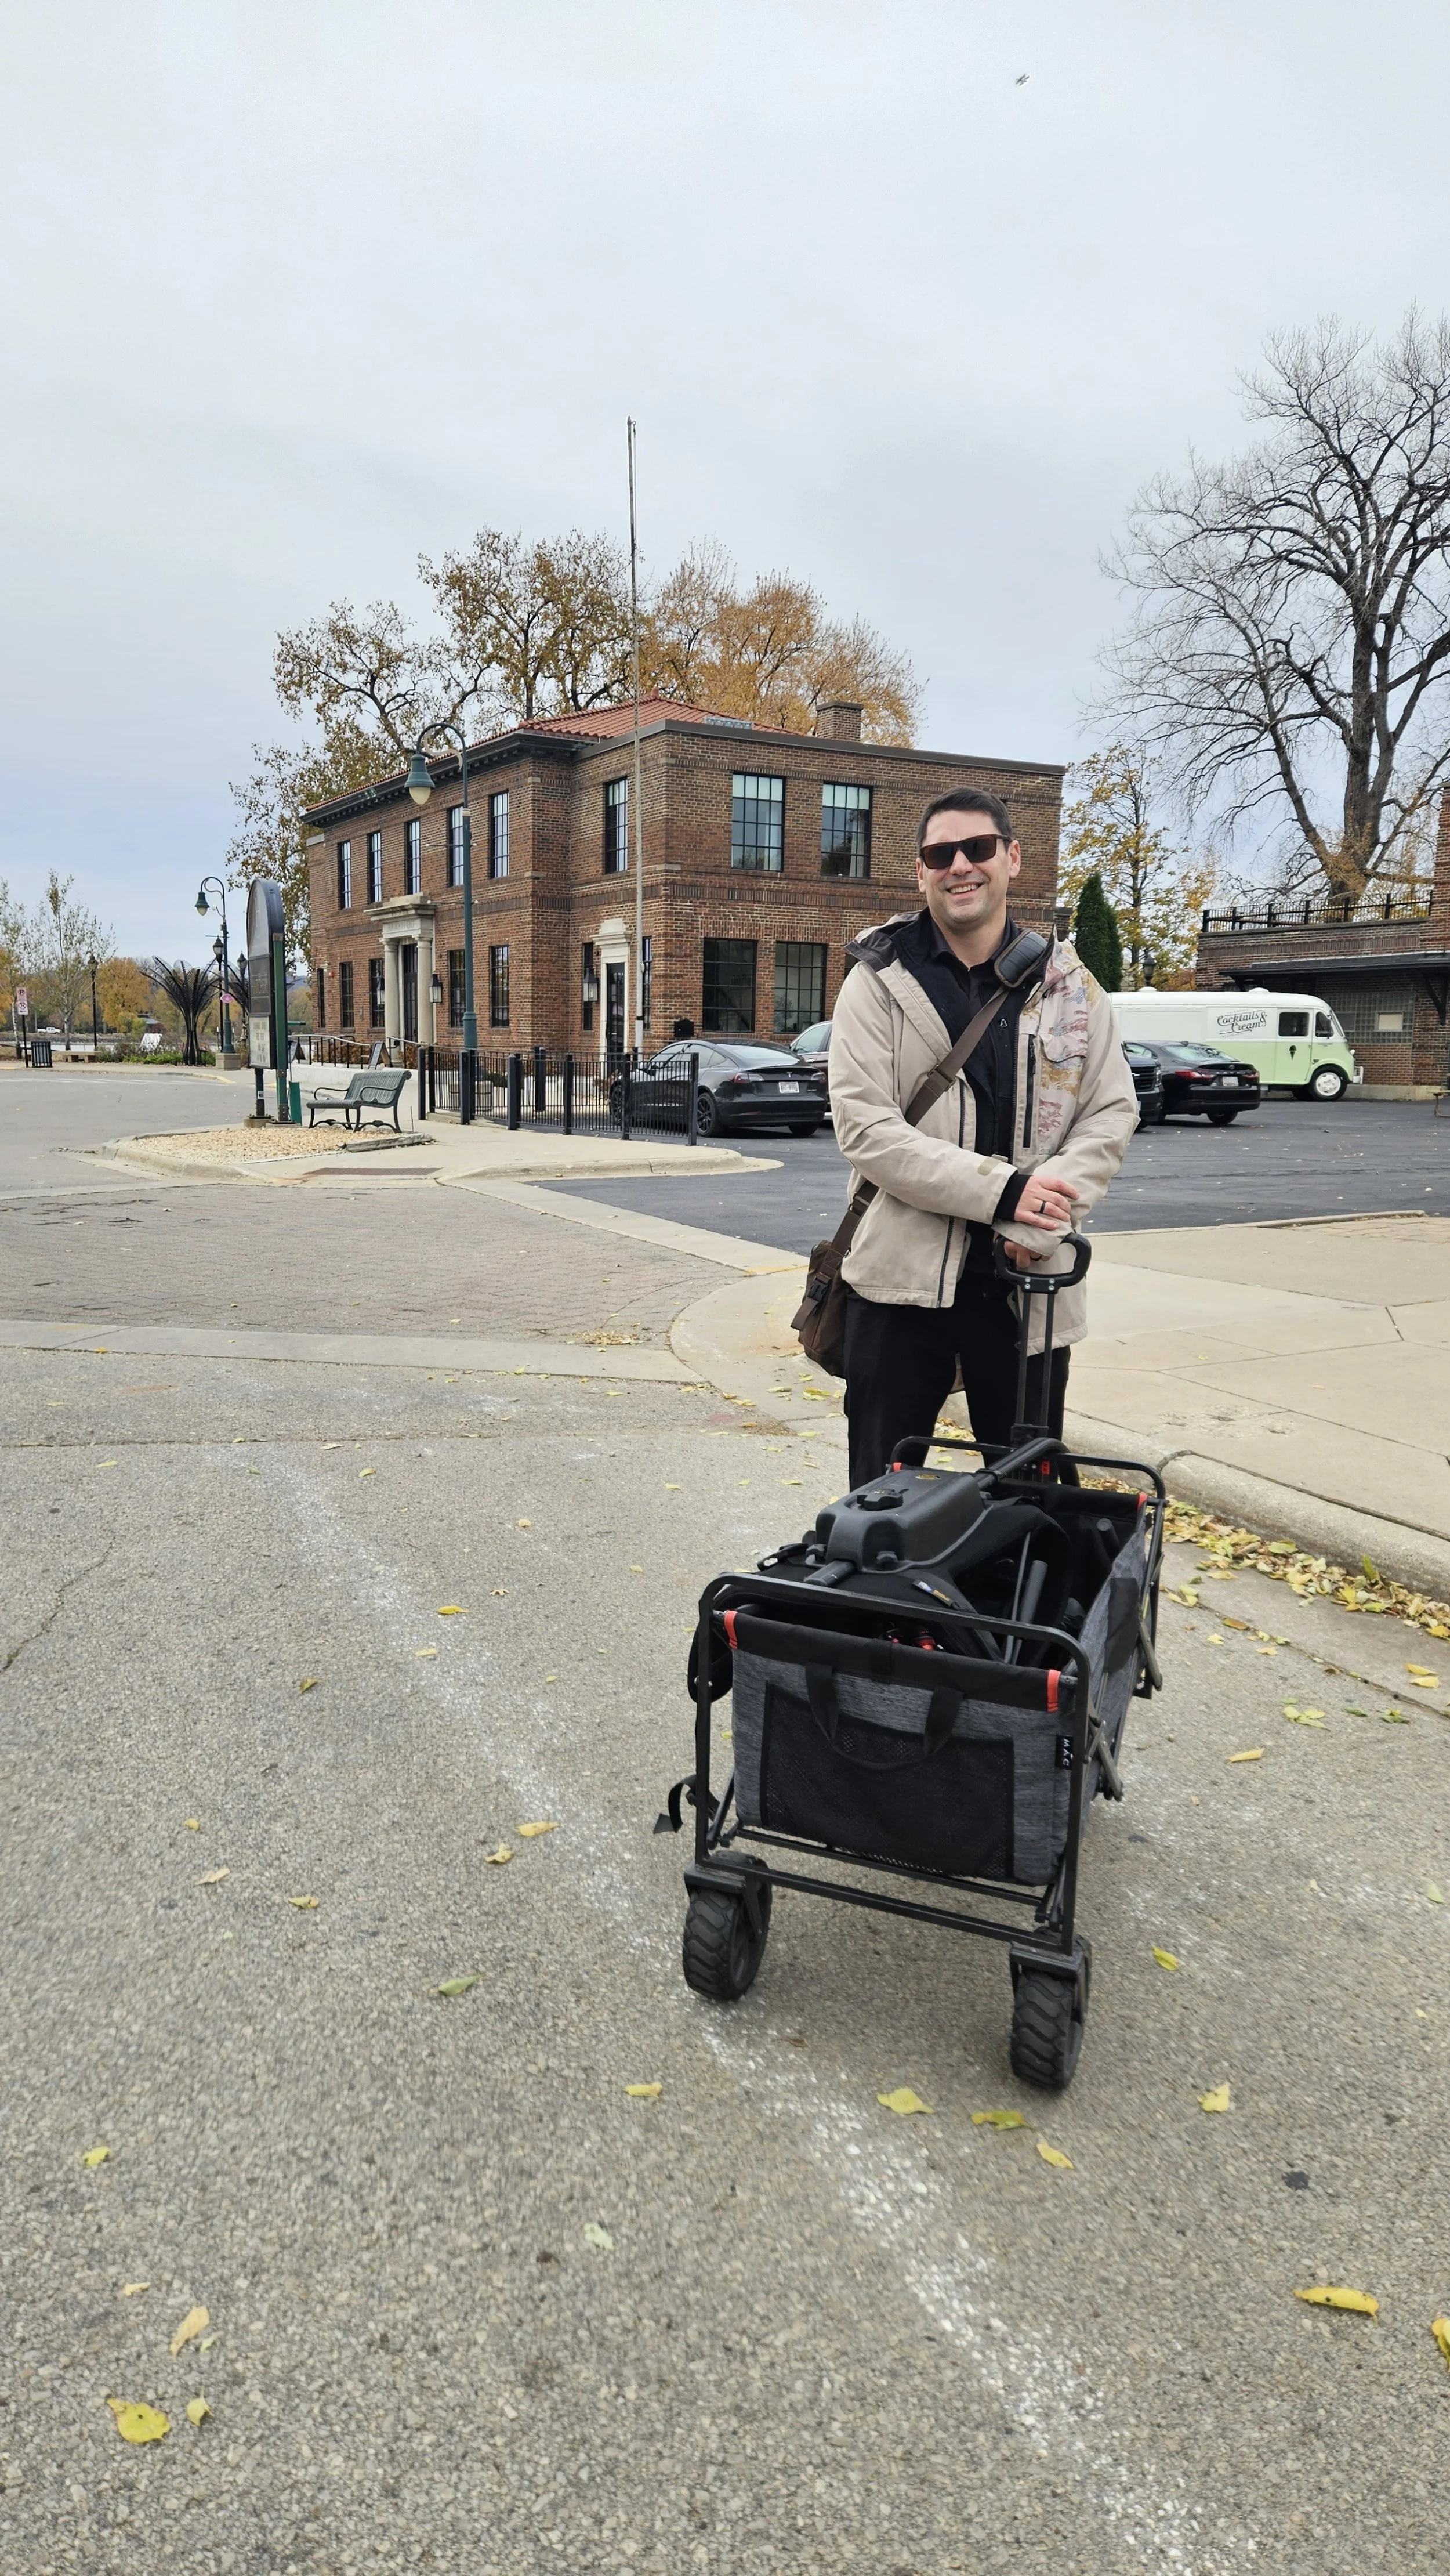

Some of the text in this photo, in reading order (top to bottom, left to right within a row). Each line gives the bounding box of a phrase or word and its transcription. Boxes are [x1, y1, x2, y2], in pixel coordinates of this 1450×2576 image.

[1217, 1011, 1267, 1027] Cocktails &
[1231, 1022, 1260, 1033] Cream
